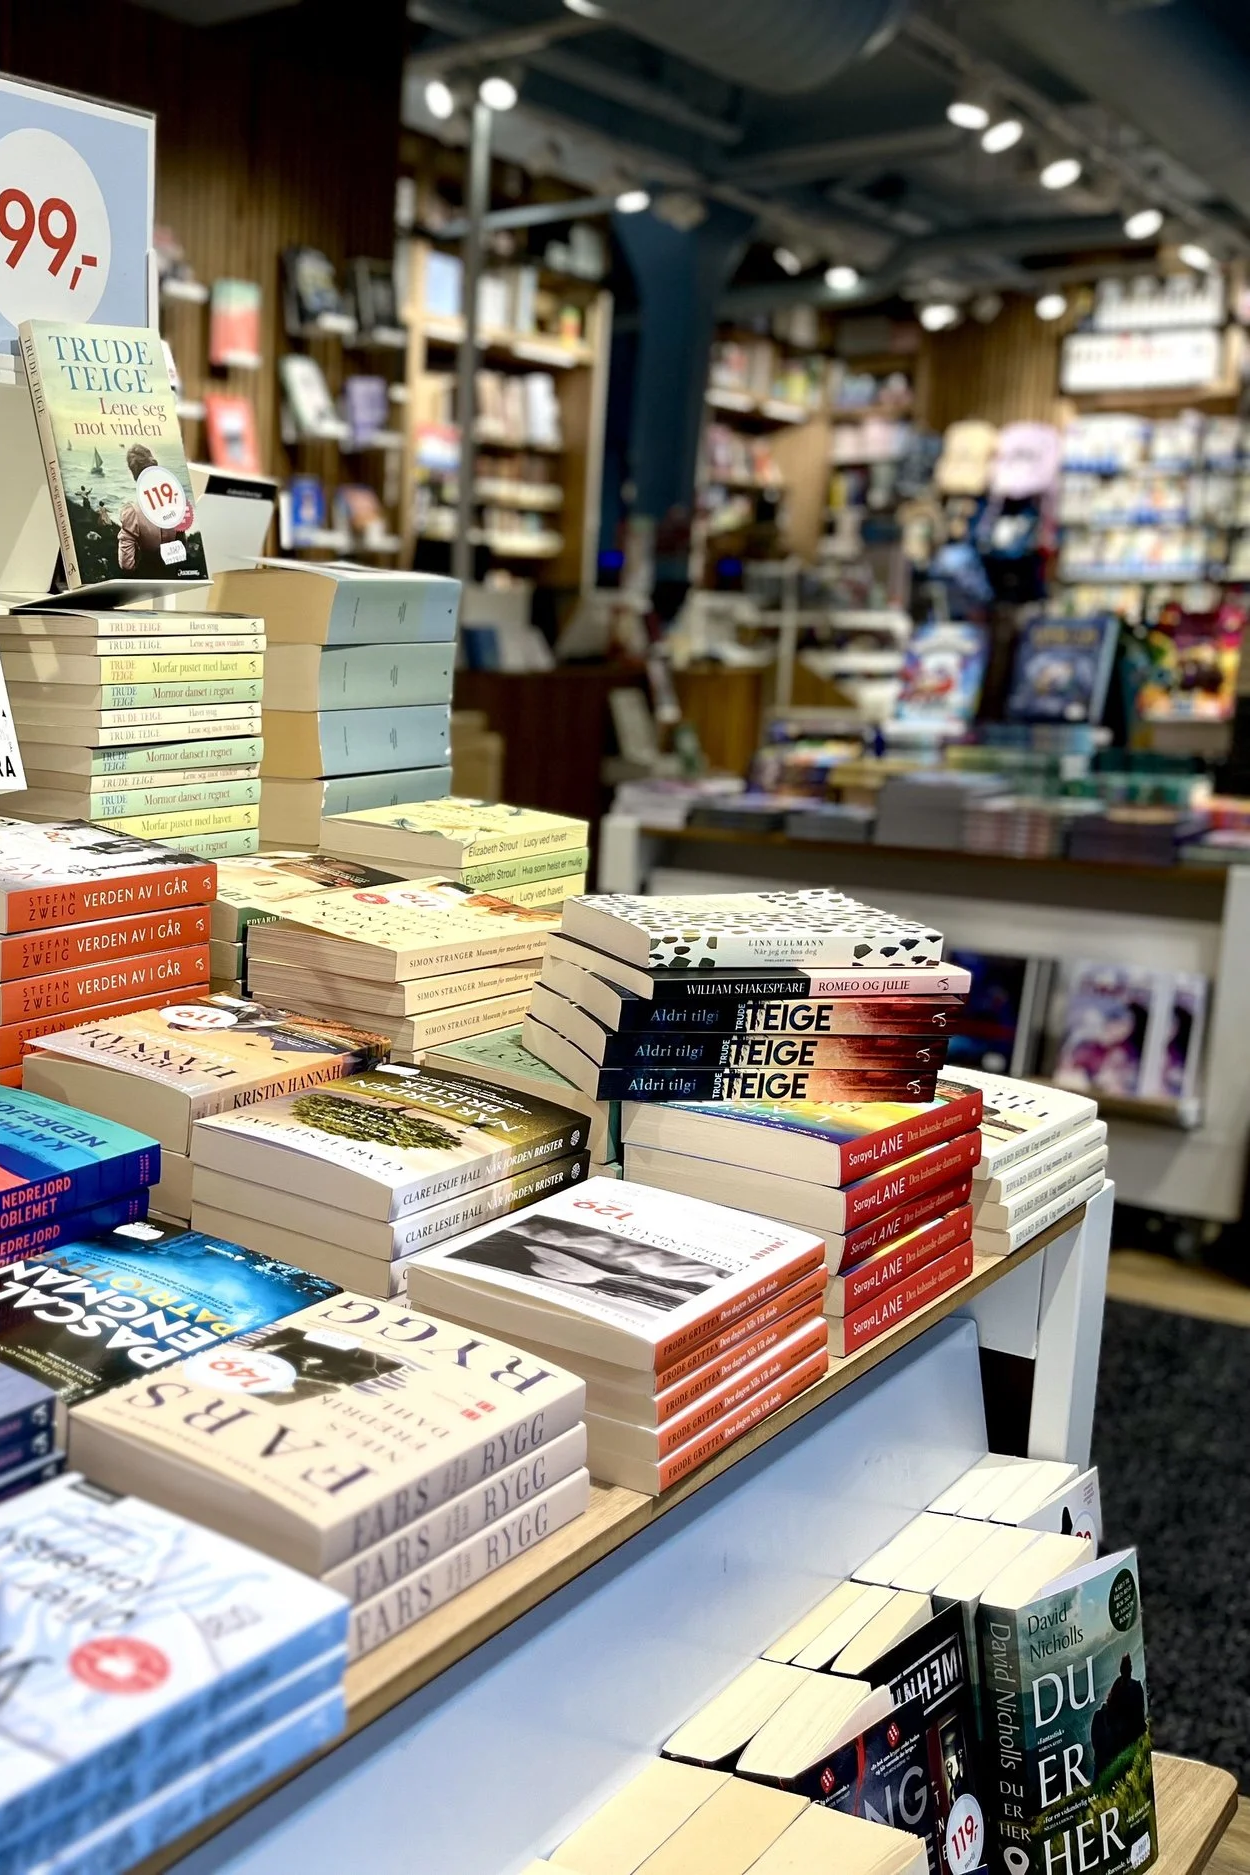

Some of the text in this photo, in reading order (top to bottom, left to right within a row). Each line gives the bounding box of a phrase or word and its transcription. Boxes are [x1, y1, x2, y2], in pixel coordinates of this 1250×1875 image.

[48, 335, 152, 365] TRUDE
[24, 336, 43, 417] TRUDE TEIGE
[61, 366, 152, 393] TEIGE
[99, 398, 164, 422] Lene seg
[74, 418, 162, 436] mot vinden
[144, 483, 179, 511] 119,-
[110, 661, 136, 671] TRUDE
[111, 671, 134, 681] TEIGE
[152, 661, 237, 675] Morfar pustet med havet
[111, 687, 137, 696] TRUDE
[113, 697, 135, 707] TEIGE
[153, 688, 183, 698] Mormor
[185, 687, 207, 697] danset
[214, 686, 234, 697] regnet
[468, 832, 567, 858] Elizabeth Strout Lucy ved havet
[29, 891, 76, 907] STEFAN
[84, 876, 188, 908] VERDEN AV I GÅR
[29, 903, 76, 922] ZWEIG
[748, 939, 824, 948] LINN ULLMANN
[409, 951, 473, 968] SIMON STRANGER
[687, 979, 910, 995] WILLIAM SHAKESPEARE ROMEO OG JULIE
[651, 1009, 719, 1025] Aldri tilgi
[736, 1003, 746, 1031] TRUDE
[747, 1002, 834, 1033] TEIGE
[233, 1064, 342, 1110] KRISTIN HANNAH
[907, 1130, 918, 1142] Den
[404, 1186, 430, 1205] CLARE
[433, 1177, 459, 1194] LESLIE
[460, 1168, 481, 1185] HALL
[503, 1148, 533, 1169] JORDEN
[534, 1138, 563, 1158] BRISTER
[2, 1176, 71, 1210] NEDREJORD
[663, 1315, 720, 1356] FRODE GRYTTEN
[485, 1502, 549, 1570] RYGG
[354, 1568, 434, 1652] FARS
[1028, 1603, 1068, 1636] David
[1029, 1626, 1083, 1663] Nicholls
[1032, 1655, 1096, 1728] DU
[1038, 1743, 1092, 1809] ER
[1044, 1806, 1126, 1875] HER
